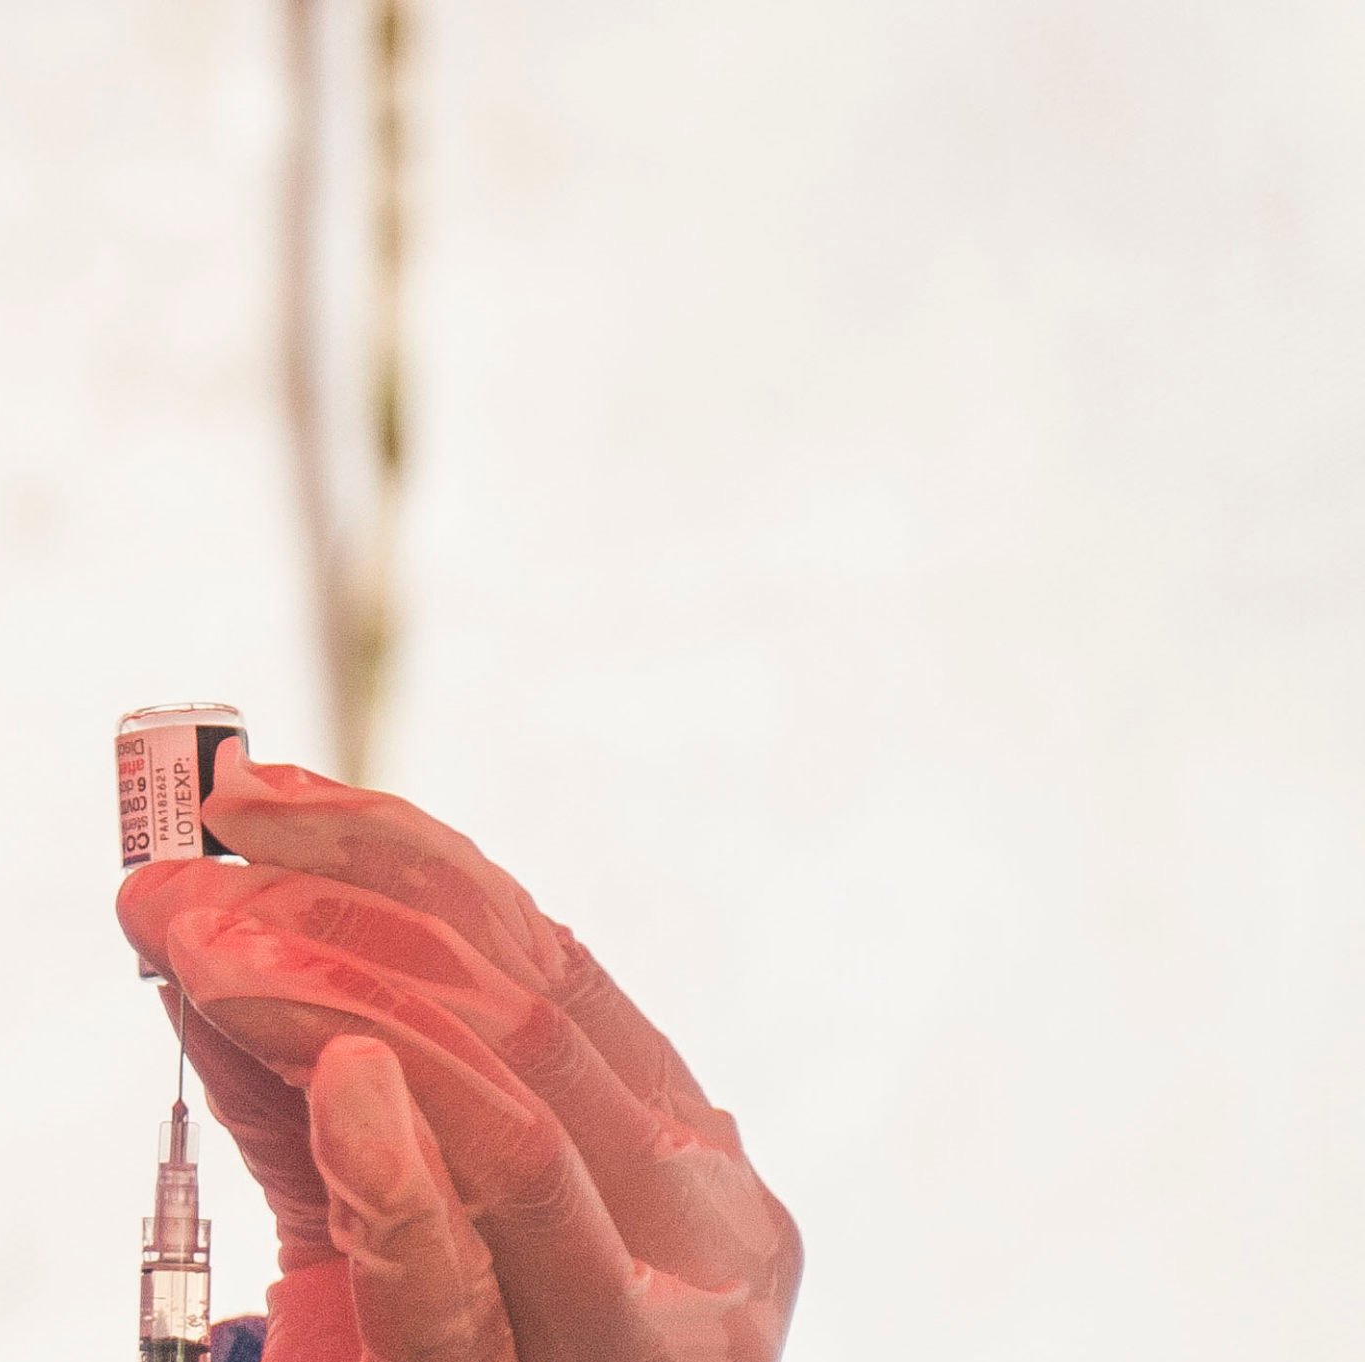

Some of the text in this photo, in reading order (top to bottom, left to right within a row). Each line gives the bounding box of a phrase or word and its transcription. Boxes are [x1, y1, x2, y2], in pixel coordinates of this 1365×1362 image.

[137, 777, 147, 793] 6
[156, 767, 169, 841] PAA182621
[173, 757, 194, 846] LOT/EXP:
